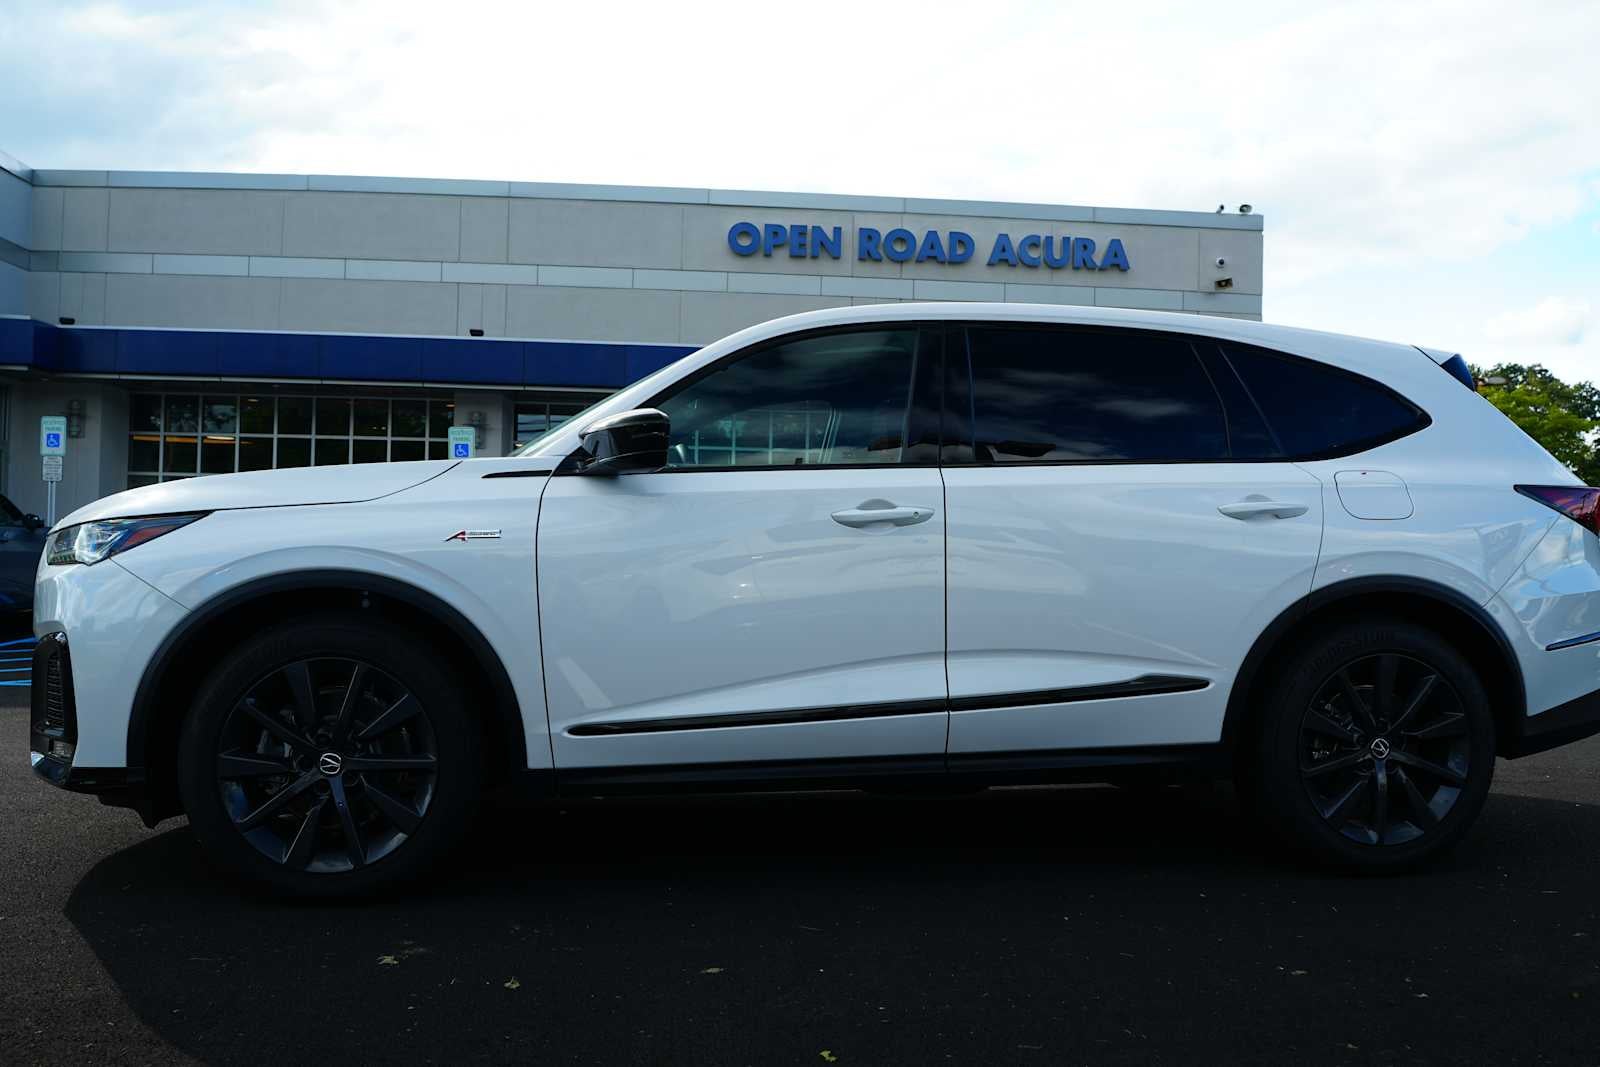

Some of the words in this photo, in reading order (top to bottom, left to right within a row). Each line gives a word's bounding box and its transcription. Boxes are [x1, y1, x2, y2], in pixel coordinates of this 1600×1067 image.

[727, 221, 843, 259] OPEN
[857, 227, 975, 265] ROAD
[986, 233, 1130, 272] ACURA
